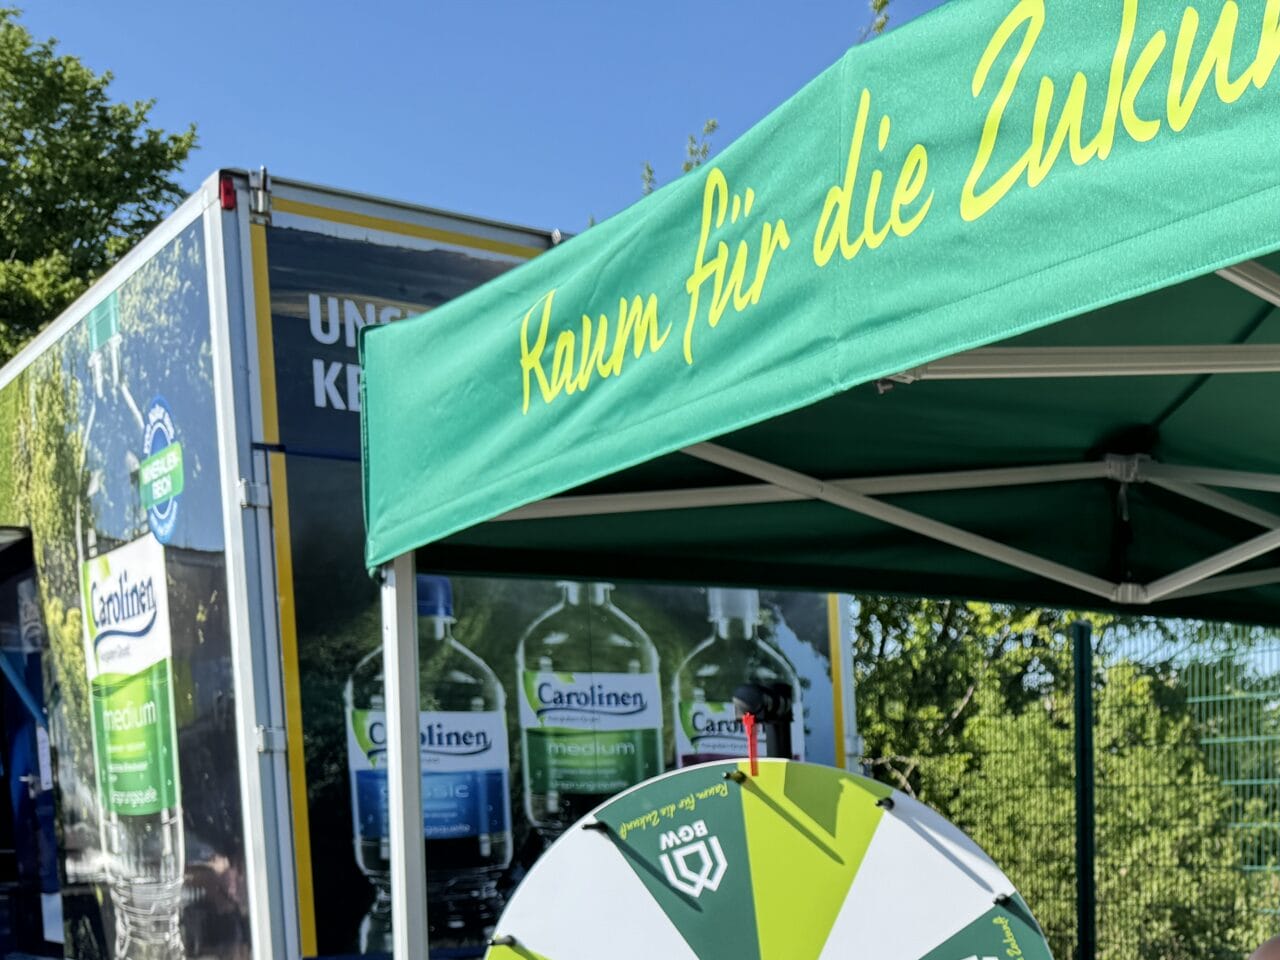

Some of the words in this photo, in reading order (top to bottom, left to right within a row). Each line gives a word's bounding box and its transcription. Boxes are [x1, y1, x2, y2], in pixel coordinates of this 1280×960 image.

[520, 288, 672, 415] Raum
[683, 167, 790, 365] für
[813, 88, 934, 267] die
[308, 293, 425, 348] UN
[91, 569, 157, 628] Carolinen
[538, 682, 646, 706] Carolinen
[369, 721, 487, 746] Clinen
[549, 741, 635, 757] medium
[659, 818, 708, 851] BGW
